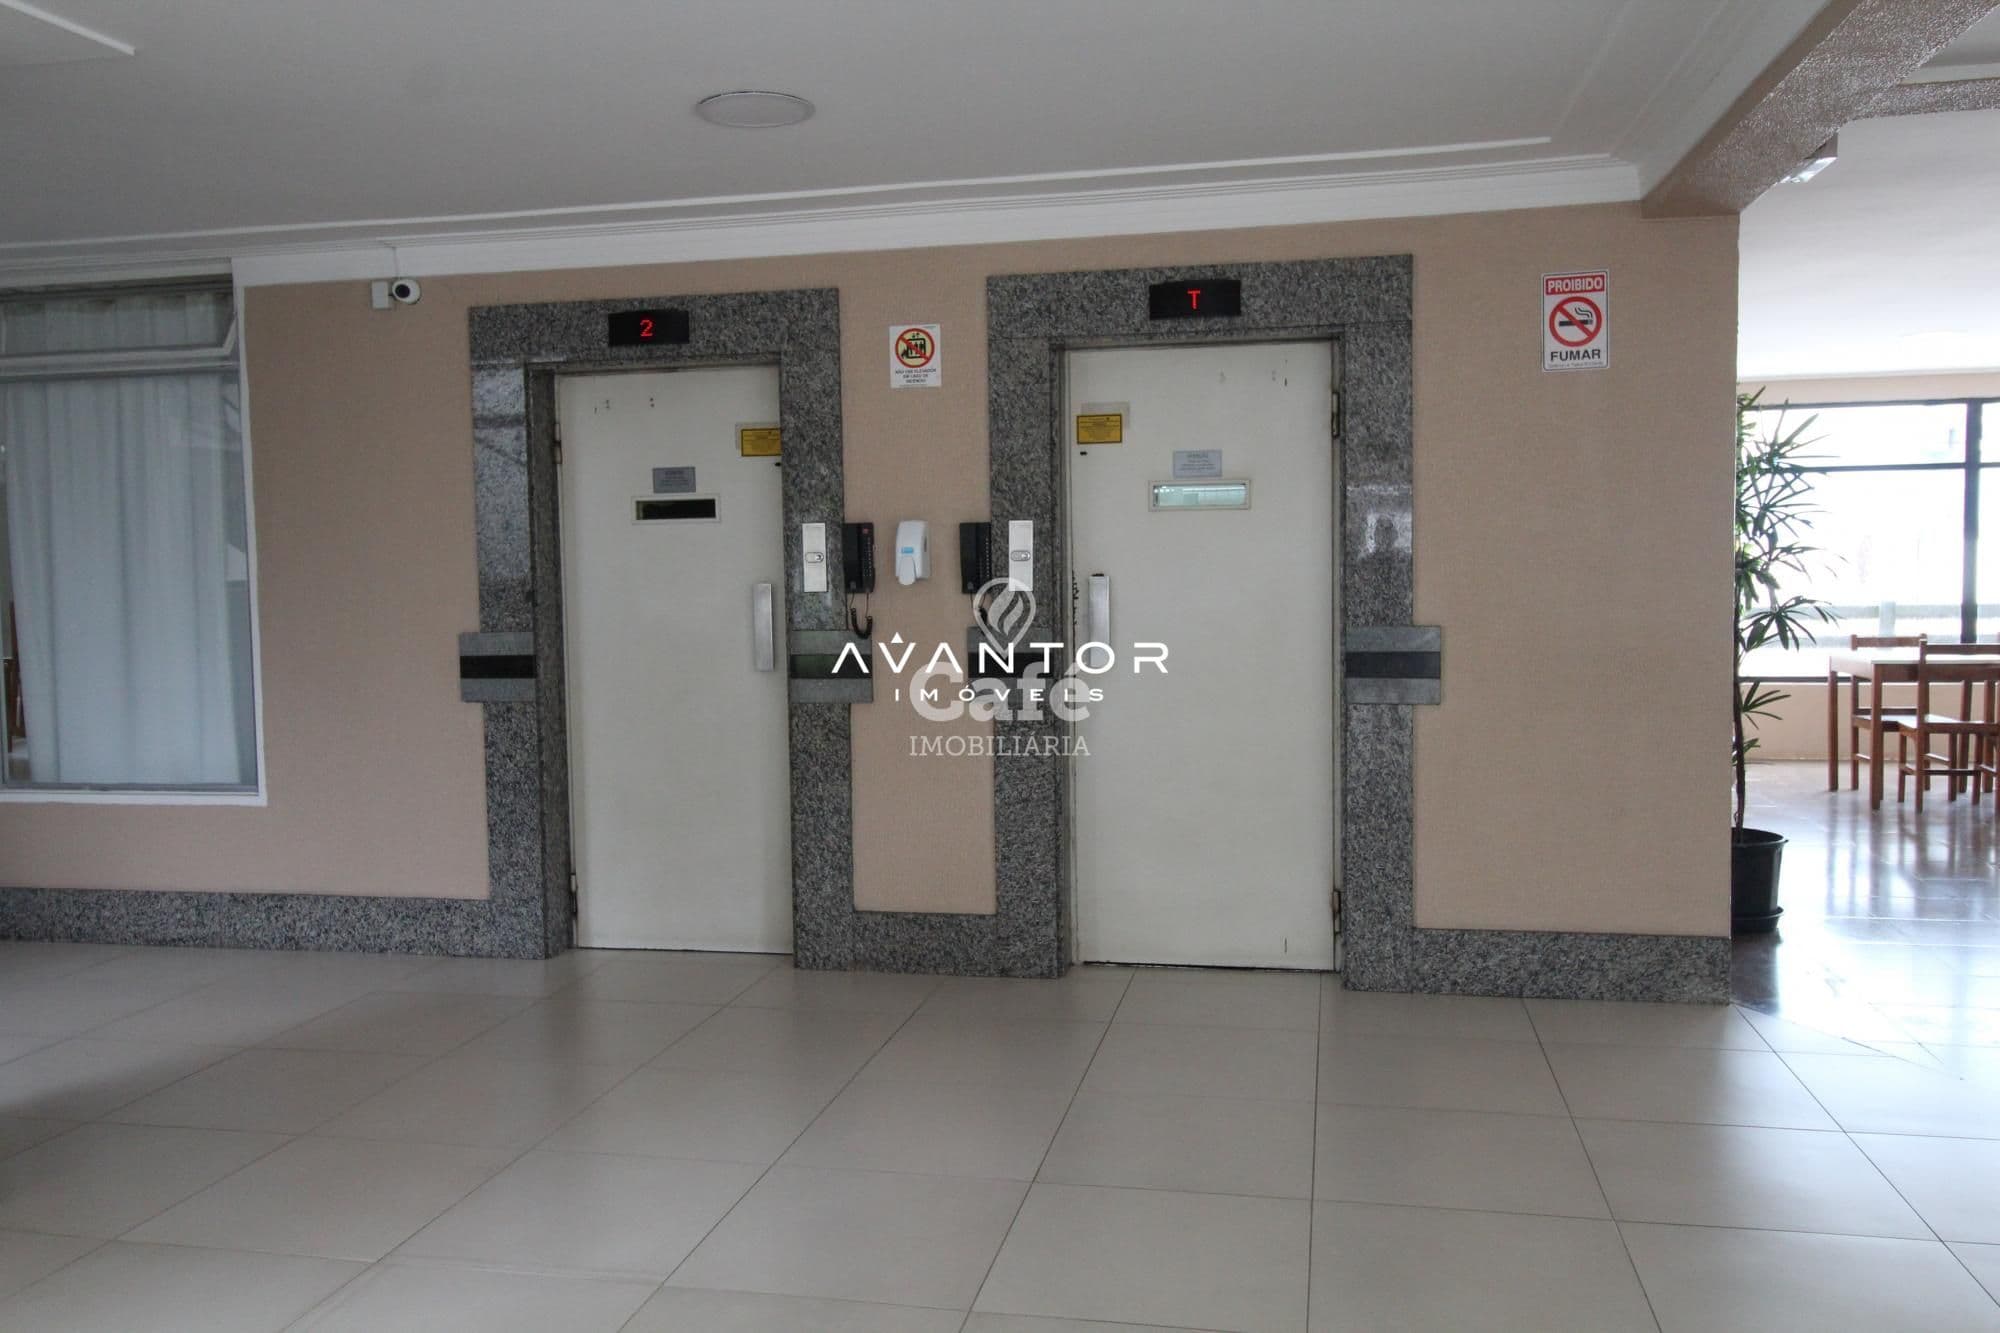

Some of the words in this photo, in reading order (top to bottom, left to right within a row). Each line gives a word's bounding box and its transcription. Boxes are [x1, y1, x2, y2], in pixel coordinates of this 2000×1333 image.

[1547, 276, 1603, 293] PROIBIDO
[1187, 289, 1201, 310] T
[639, 318, 655, 338] 2
[1550, 349, 1601, 362] FUMAR
